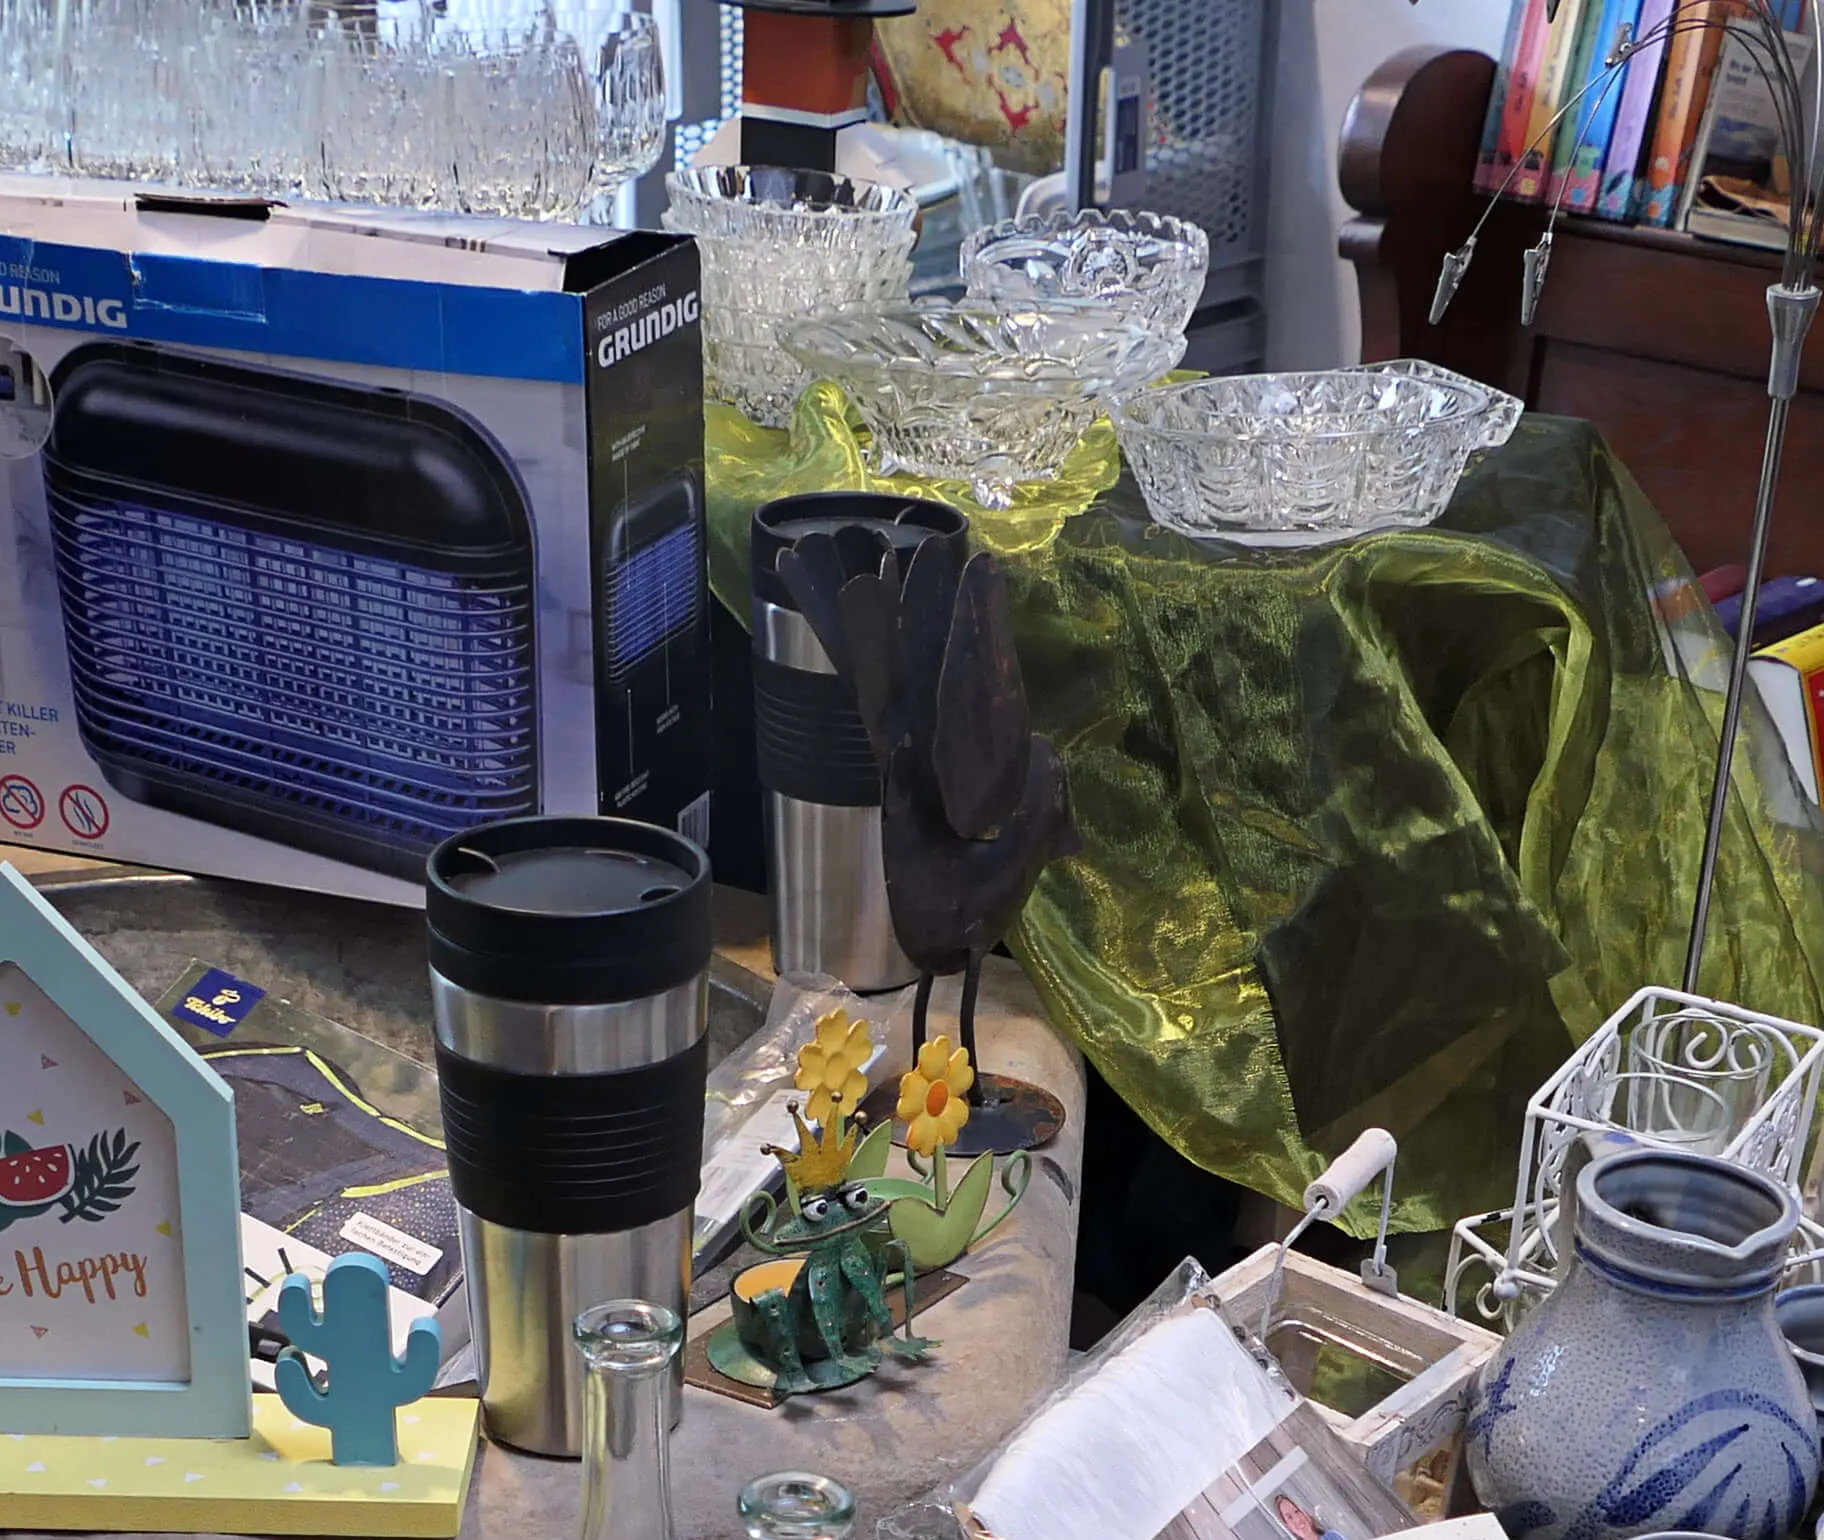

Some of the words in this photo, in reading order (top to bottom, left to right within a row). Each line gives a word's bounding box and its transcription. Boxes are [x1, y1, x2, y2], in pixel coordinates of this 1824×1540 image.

[10, 263, 61, 285] REASON
[598, 311, 613, 331] FOR
[618, 298, 638, 321] GOOD
[638, 283, 667, 311] REASON
[598, 290, 699, 368] GRUNDIG
[8, 703, 59, 722] KILLER
[14, 1246, 147, 1305] Happy
